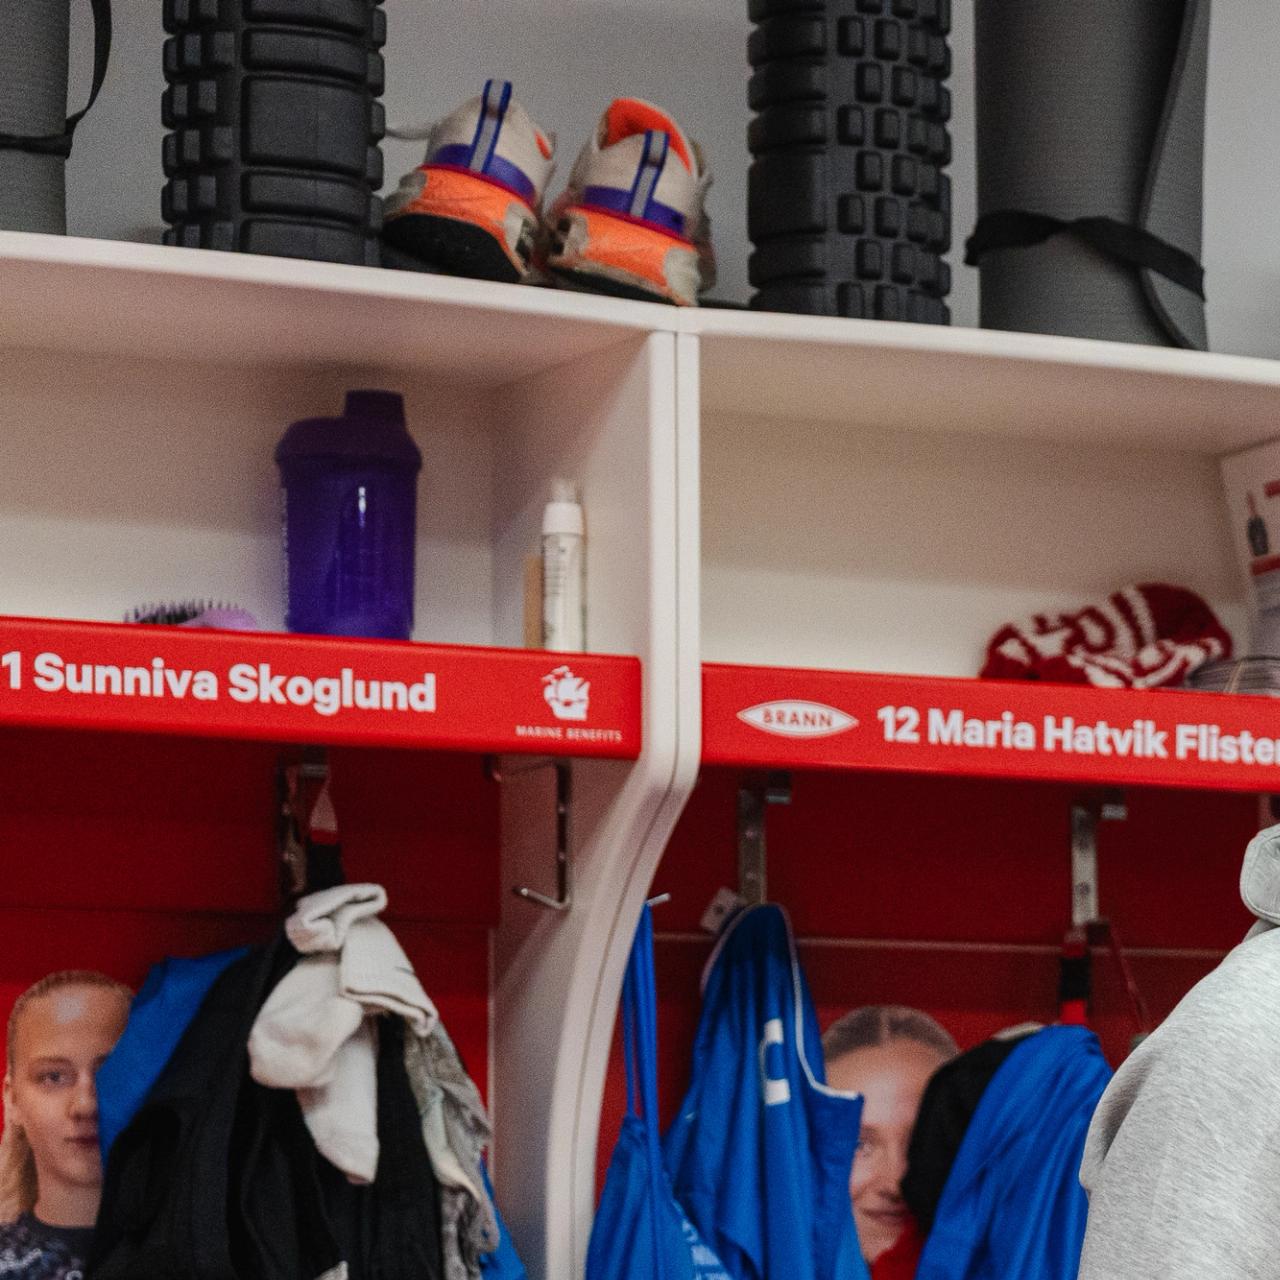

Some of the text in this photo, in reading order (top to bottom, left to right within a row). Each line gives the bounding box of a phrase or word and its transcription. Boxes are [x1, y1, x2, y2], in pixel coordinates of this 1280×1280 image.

[34, 651, 218, 700] Sunniva
[228, 664, 437, 716] Skoglund
[515, 725, 622, 743] MARINE BENEFITS
[761, 709, 833, 728] BRANN
[877, 705, 920, 743] 12
[927, 707, 1035, 749] Maria
[1043, 715, 1169, 759] Hatvik
